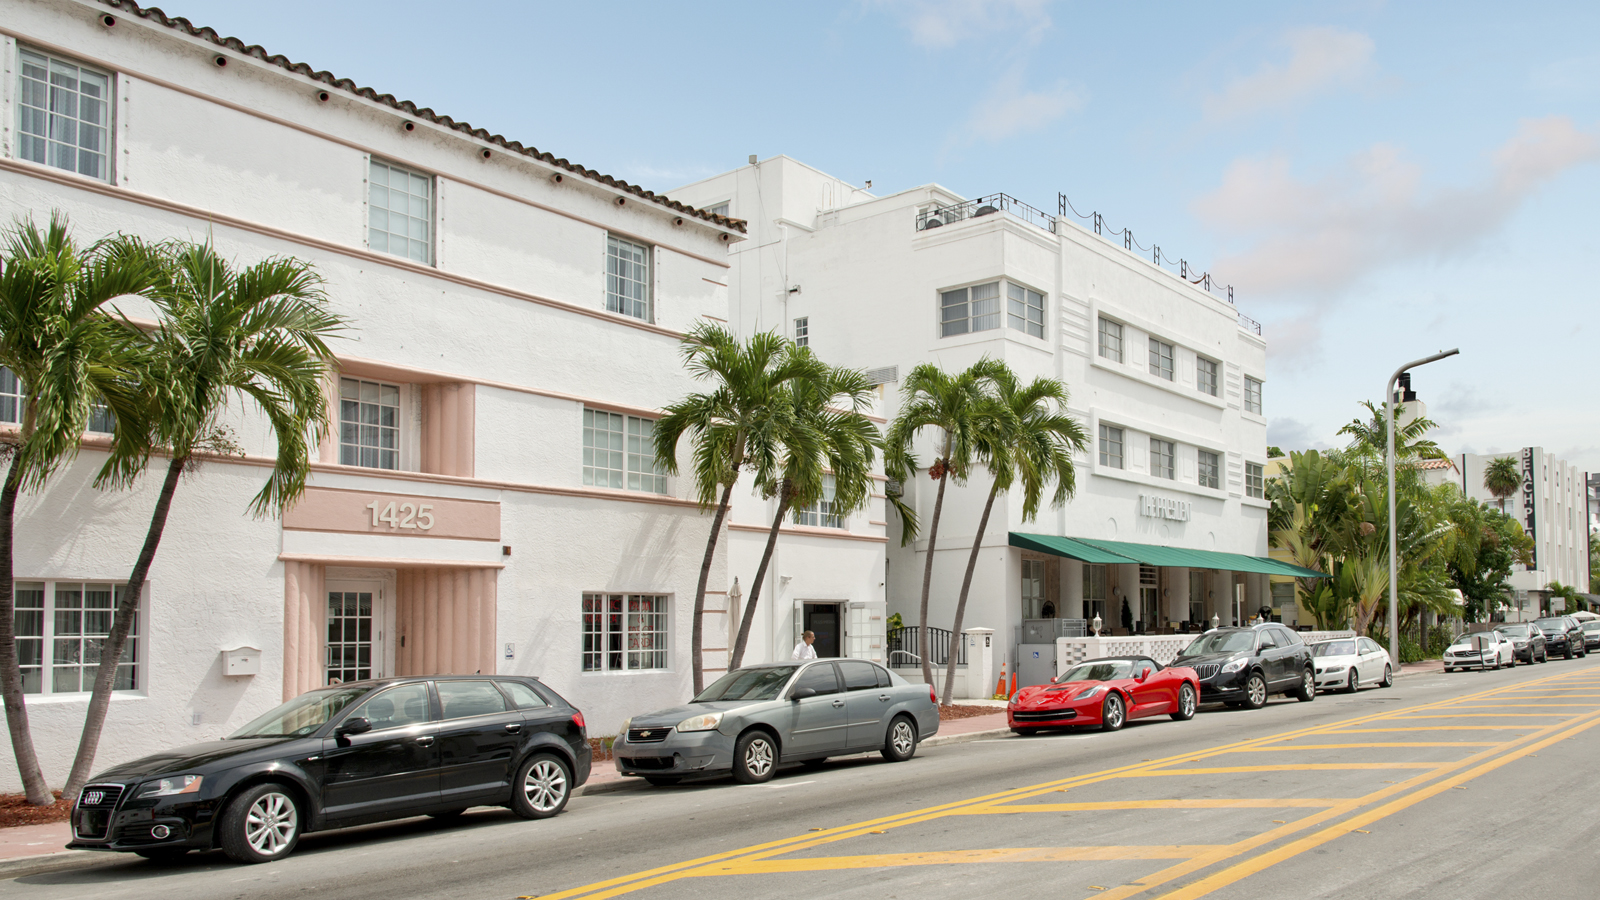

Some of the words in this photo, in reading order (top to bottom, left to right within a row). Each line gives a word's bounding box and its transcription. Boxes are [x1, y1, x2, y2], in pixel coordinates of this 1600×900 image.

[1522, 447, 1533, 504] BEACH
[366, 500, 435, 530] 1425
[1524, 507, 1535, 566] PLA
